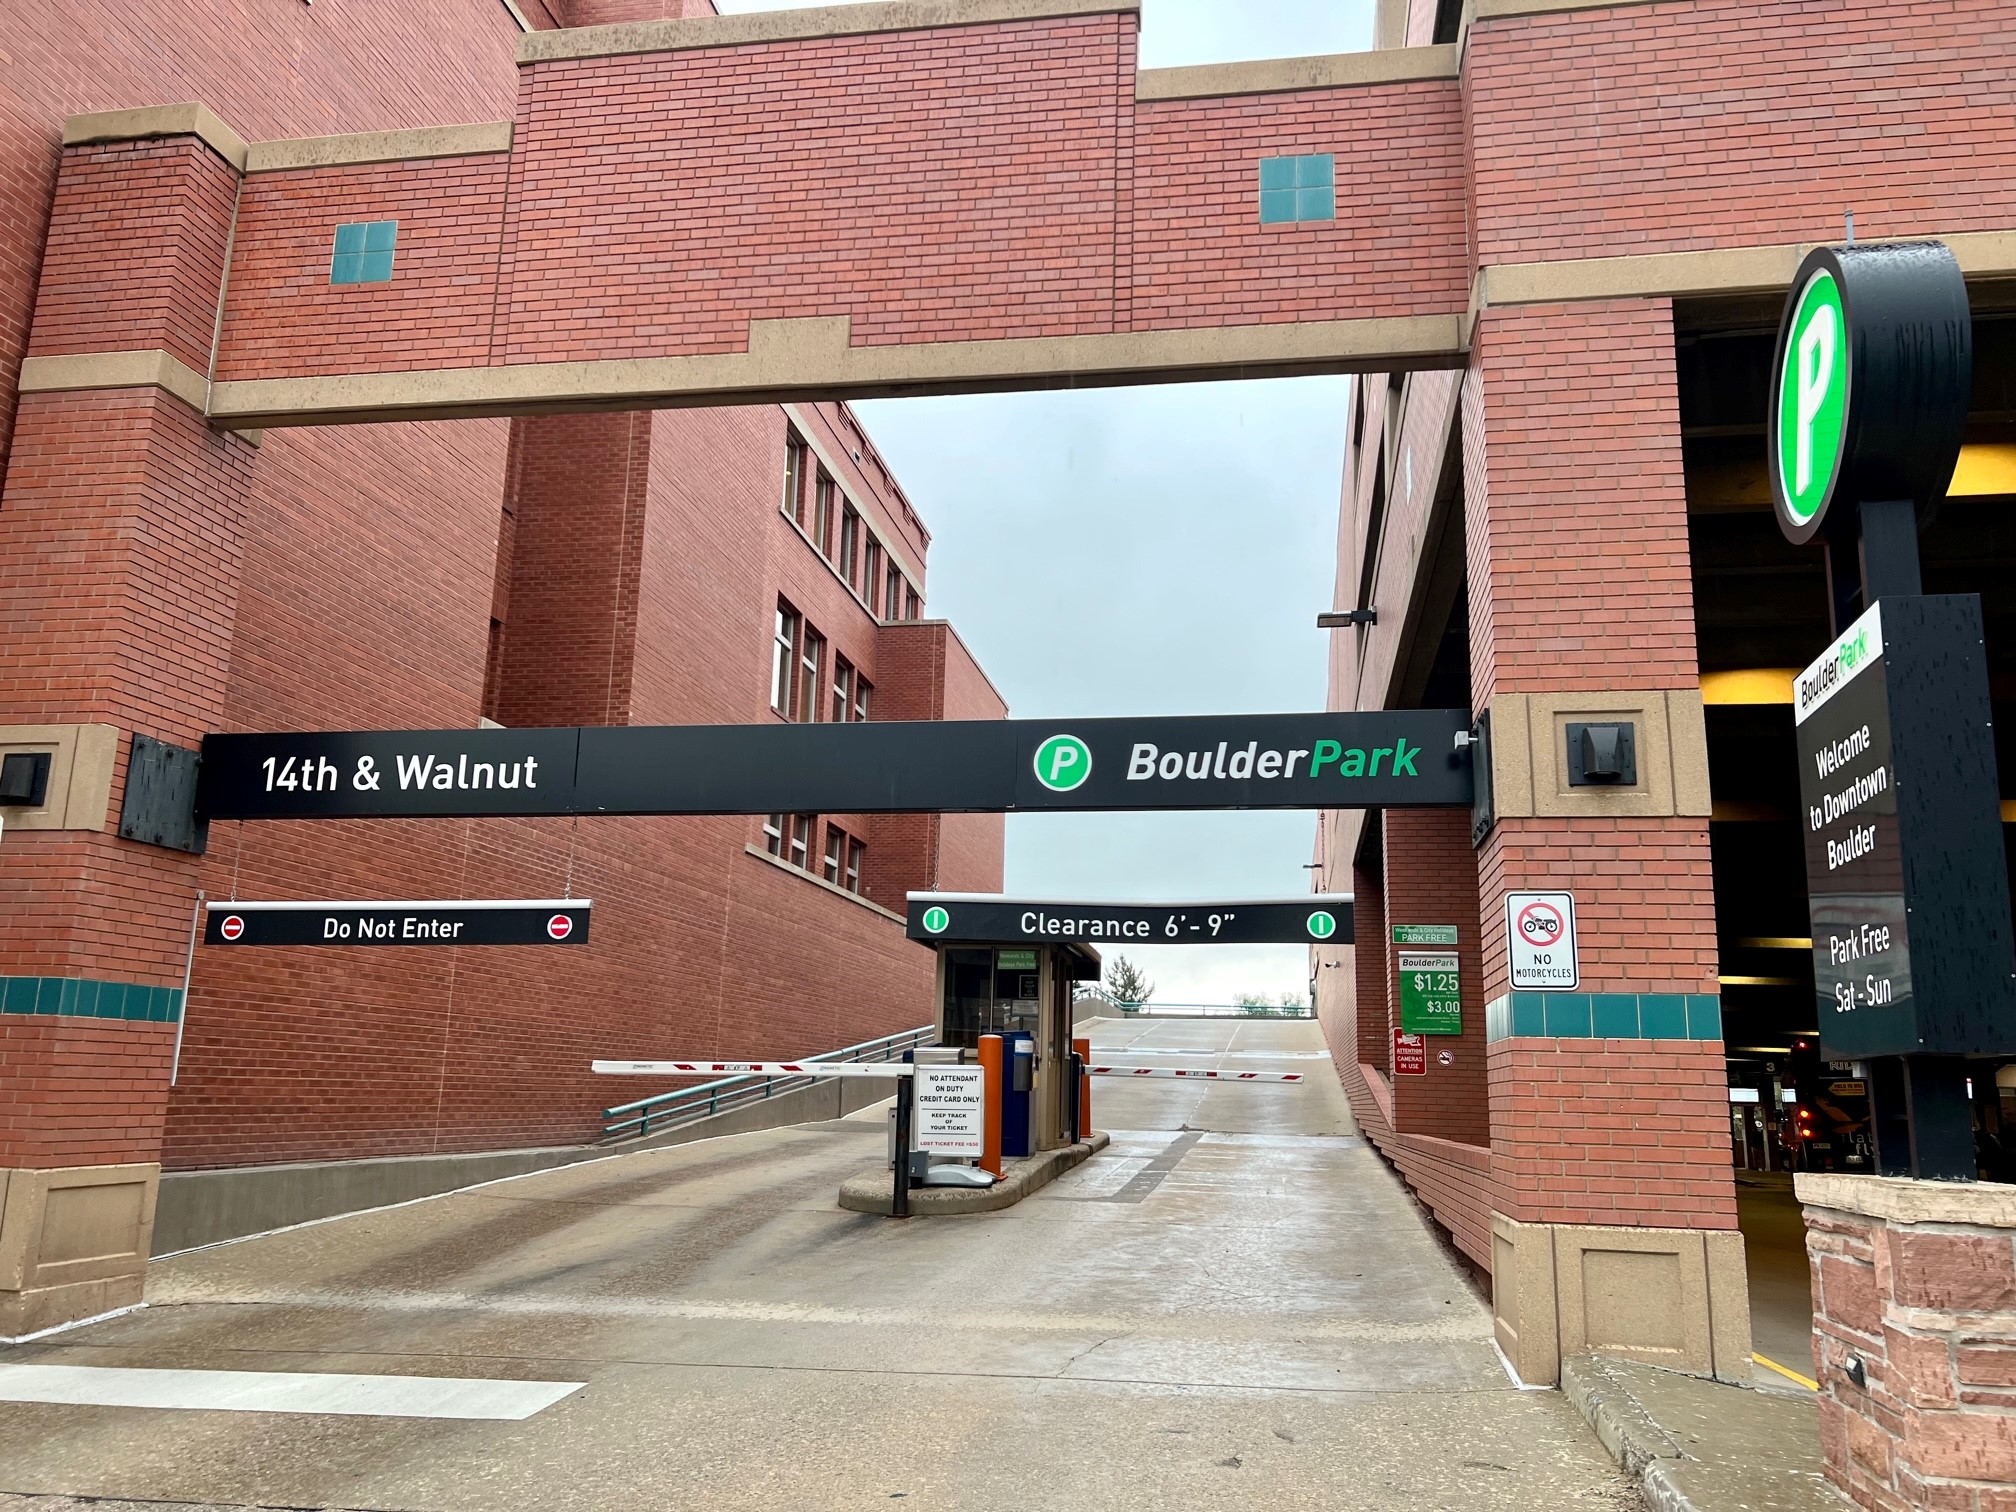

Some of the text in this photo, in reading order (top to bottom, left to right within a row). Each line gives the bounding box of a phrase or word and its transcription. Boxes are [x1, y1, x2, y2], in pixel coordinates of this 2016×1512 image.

[1796, 304, 1836, 496] P
[1802, 628, 1868, 708] BoulderPark
[1050, 746, 1078, 781] P
[1126, 738, 1422, 781] BoulderPark
[1816, 725, 1870, 780] Welcome
[262, 753, 539, 792] 14th & Walnut
[1810, 766, 1887, 831] to Downtown
[1827, 824, 1876, 871] Boulder
[324, 918, 464, 938] Do Not Enter
[1021, 912, 1150, 937] Clearance
[1426, 934, 1447, 942] FREE
[1403, 958, 1455, 967] BoulderPark
[1534, 954, 1552, 965] NO
[1830, 924, 1890, 966] Park Free
[1414, 972, 1459, 992] $1.25
[1516, 968, 1572, 978] MOTORCYCLES
[1427, 1000, 1460, 1013] $3.00
[1835, 982, 1856, 1012] Sat
[1866, 974, 1892, 1006] Sun
[1766, 1062, 1776, 1072] 3
